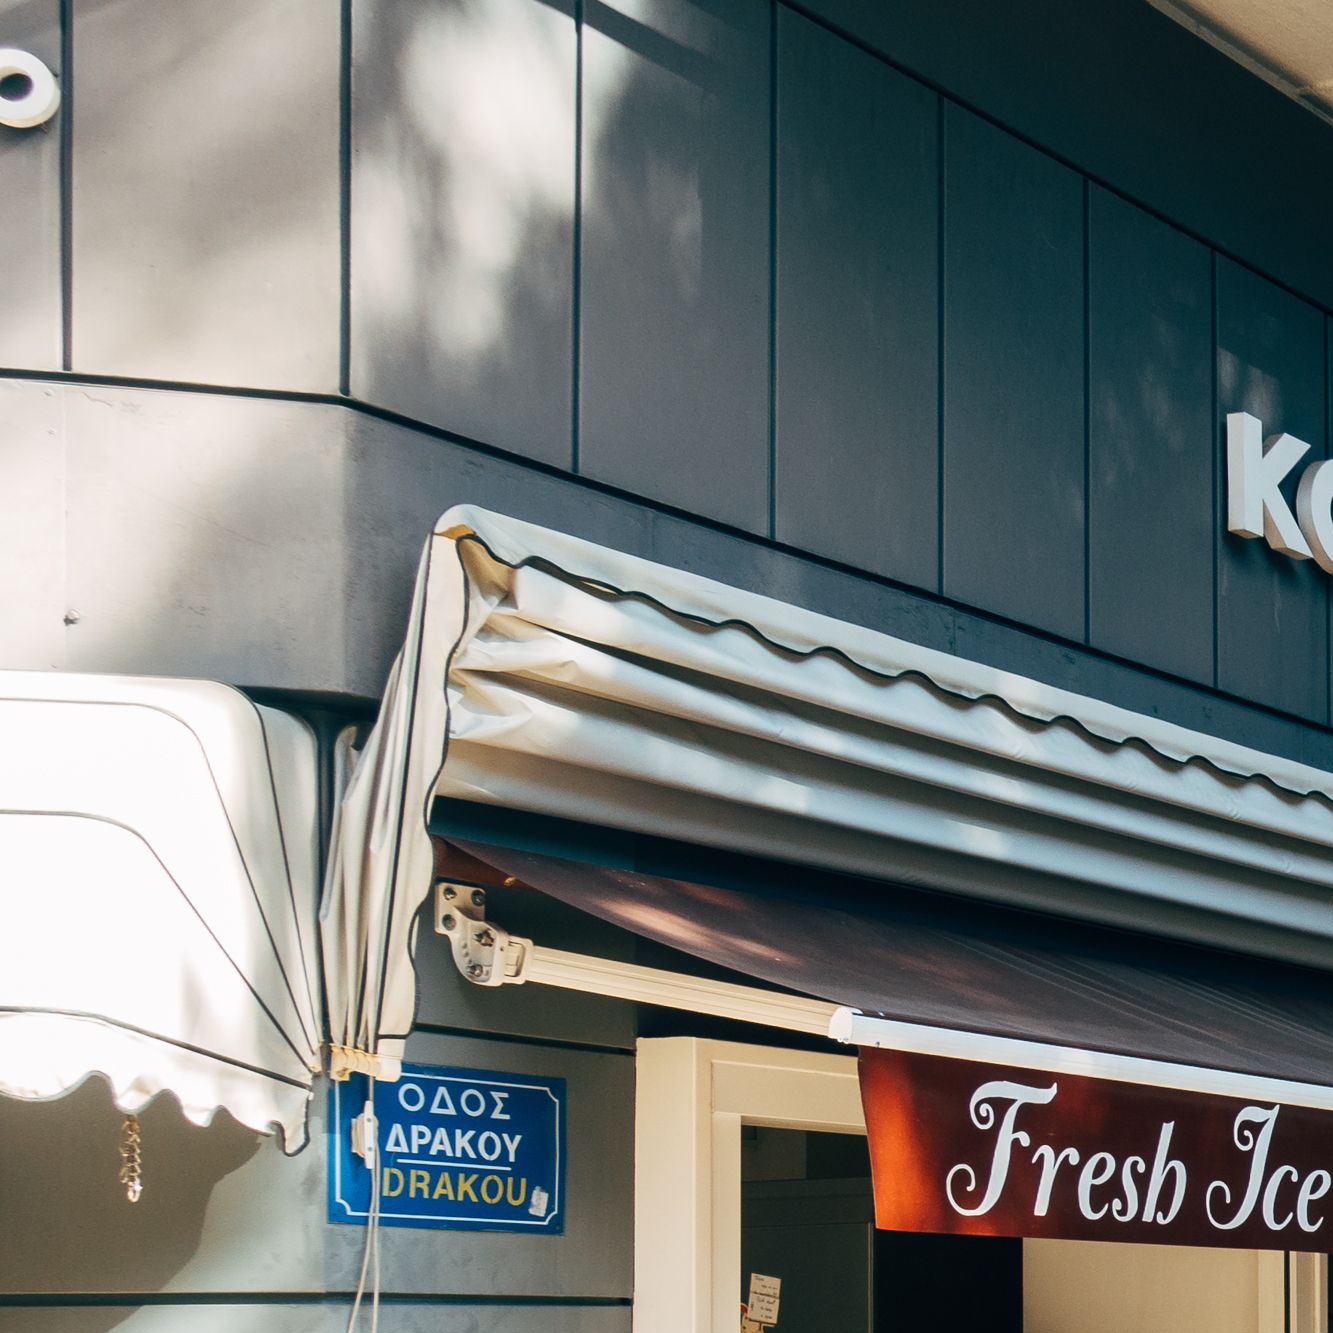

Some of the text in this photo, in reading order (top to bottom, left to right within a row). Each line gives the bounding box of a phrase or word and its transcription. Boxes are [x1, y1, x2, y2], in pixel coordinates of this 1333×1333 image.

[398, 1083, 511, 1120] ΟΔΟΣ
[385, 1123, 523, 1163] ΔΡΑΚΟΥ
[946, 1080, 1187, 1226] Fresh
[1206, 1104, 1332, 1232] Ice
[381, 1167, 527, 1206] DRAKOU
